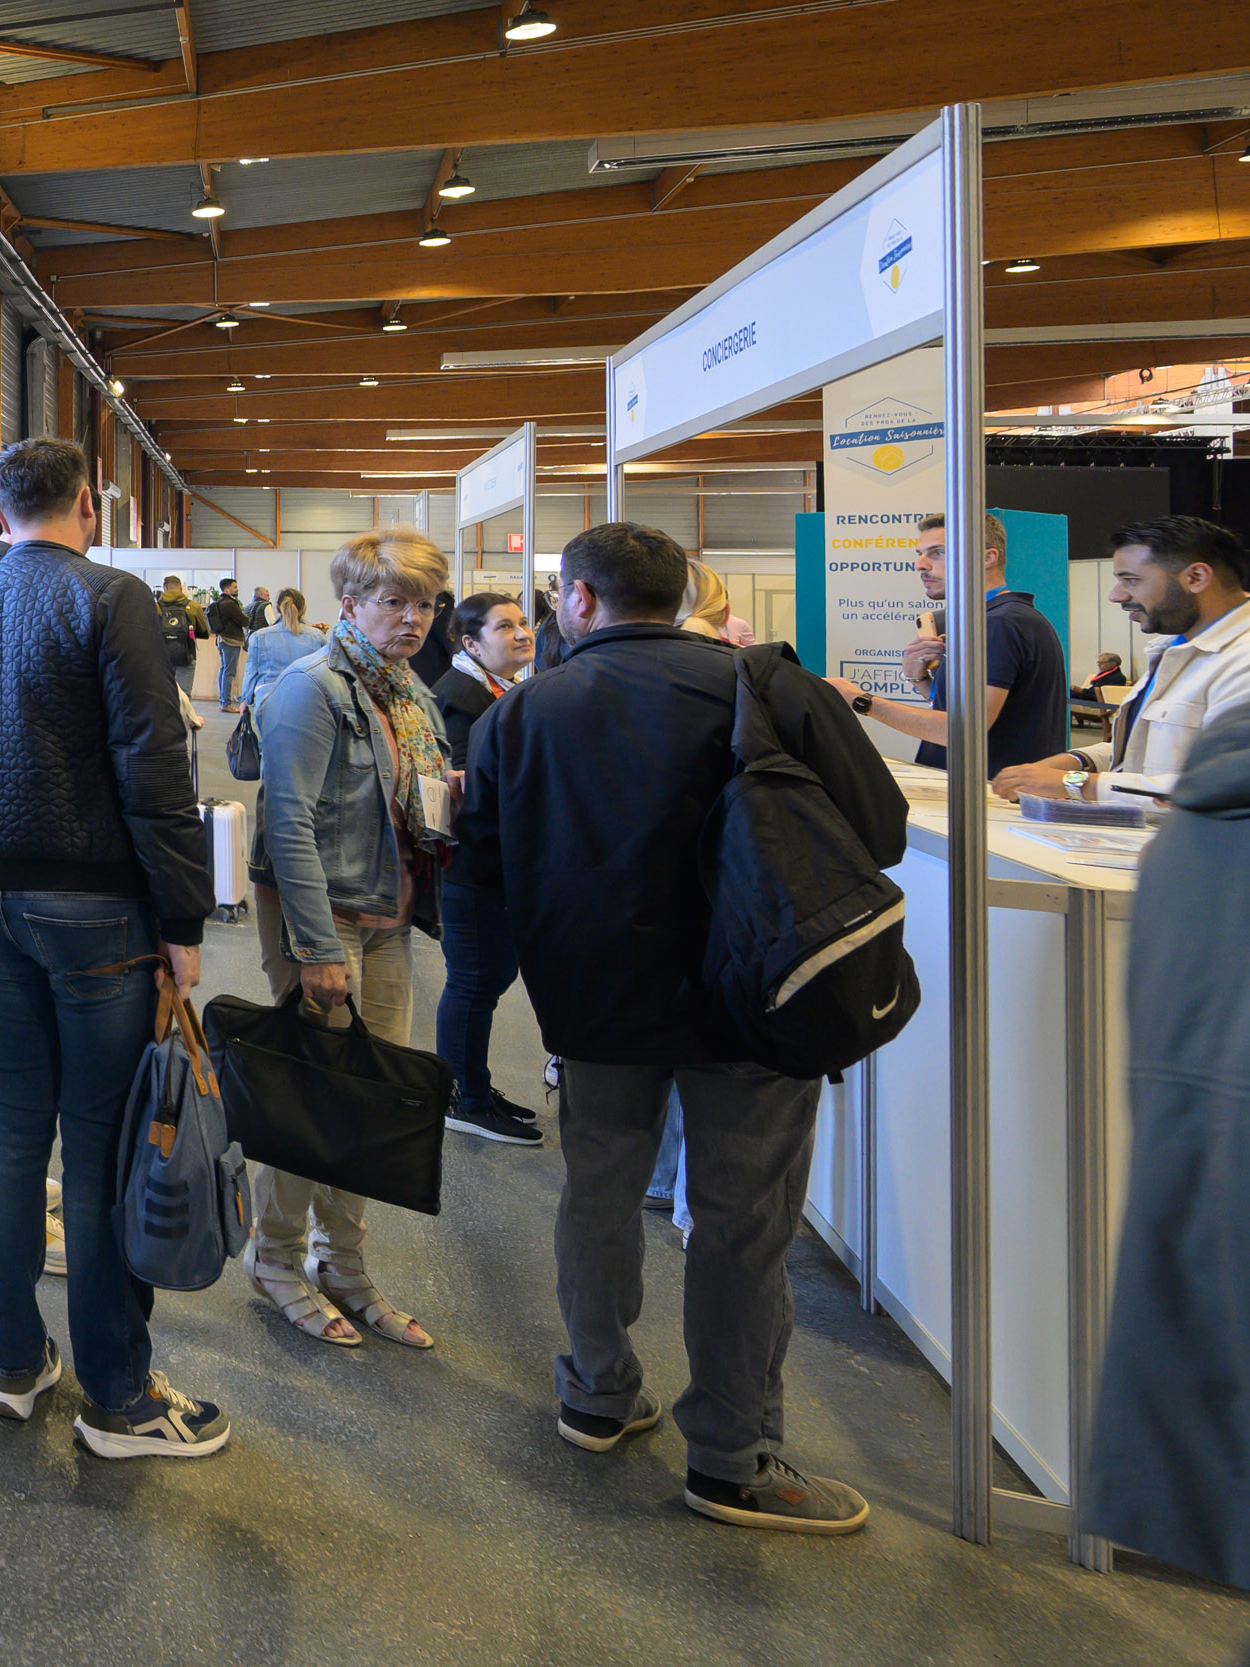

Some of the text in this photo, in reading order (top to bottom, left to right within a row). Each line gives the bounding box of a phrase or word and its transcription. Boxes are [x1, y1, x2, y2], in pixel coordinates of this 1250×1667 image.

[702, 321, 757, 372] CONCIERGERIE
[864, 411, 913, 419] RENDEZ-VOUS
[832, 432, 881, 447] Location
[836, 513, 934, 525] RENCONTR
[838, 598, 944, 610] Plus qu'un salon
